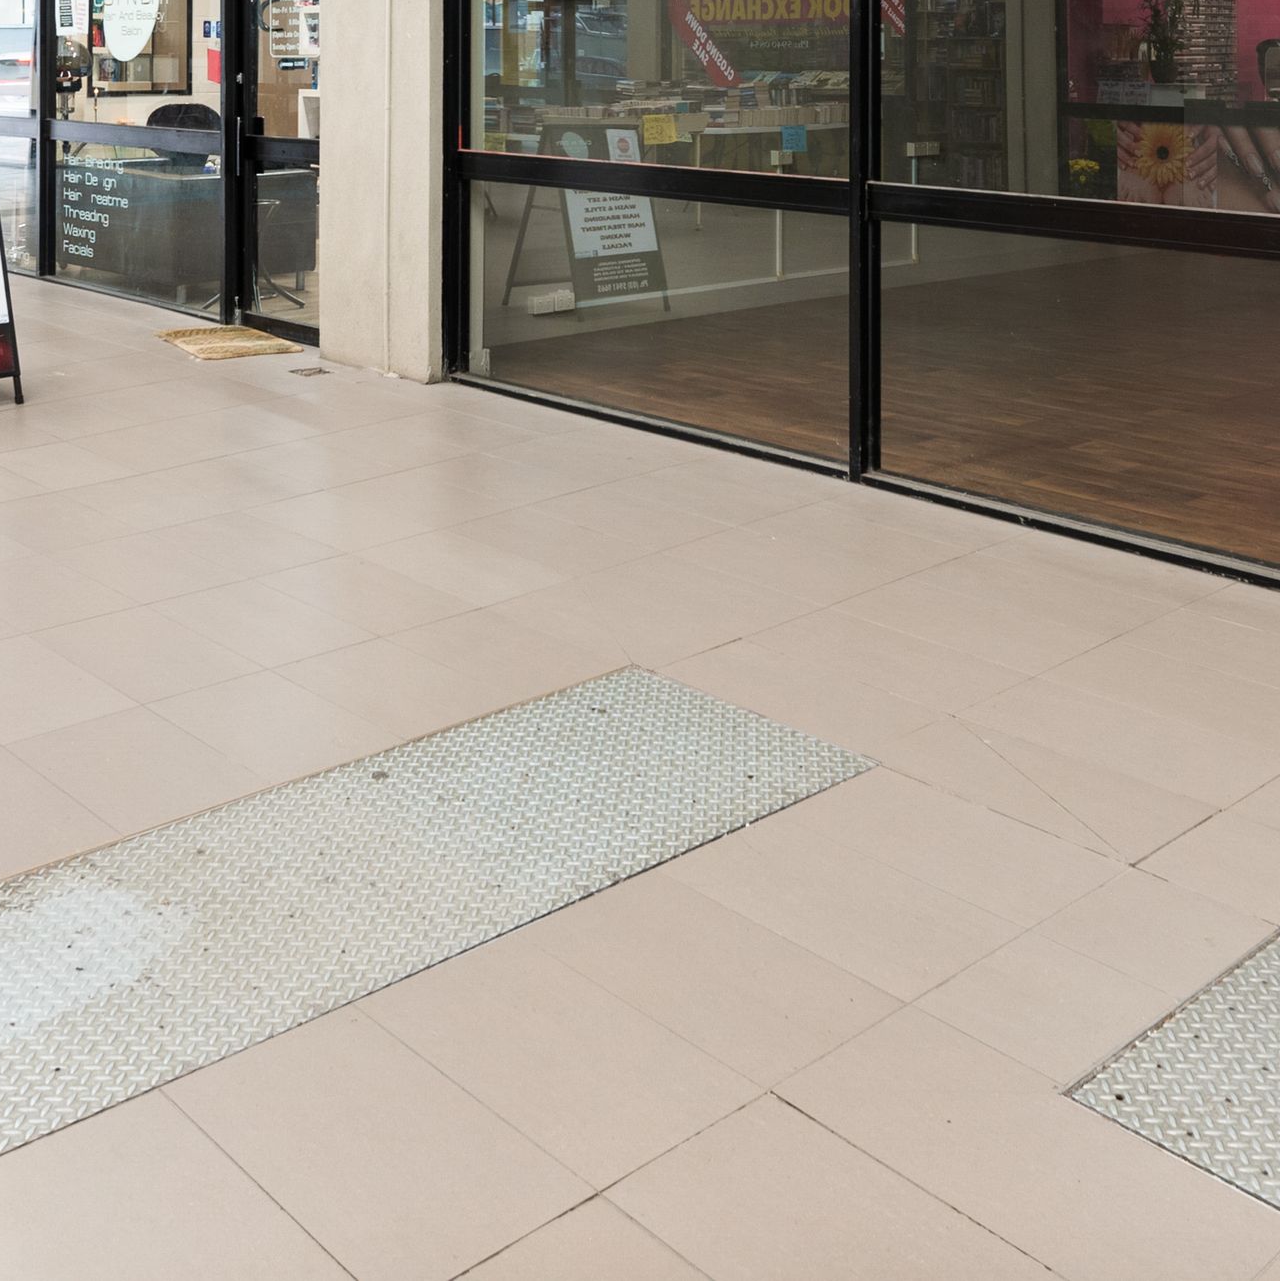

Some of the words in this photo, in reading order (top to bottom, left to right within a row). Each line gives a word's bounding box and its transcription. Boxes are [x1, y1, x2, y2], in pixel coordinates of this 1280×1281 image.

[63, 170, 83, 184] Hair
[63, 187, 83, 201] Hair
[63, 204, 110, 227] Threading
[63, 222, 96, 244] Waxing
[63, 239, 95, 258] Facials
